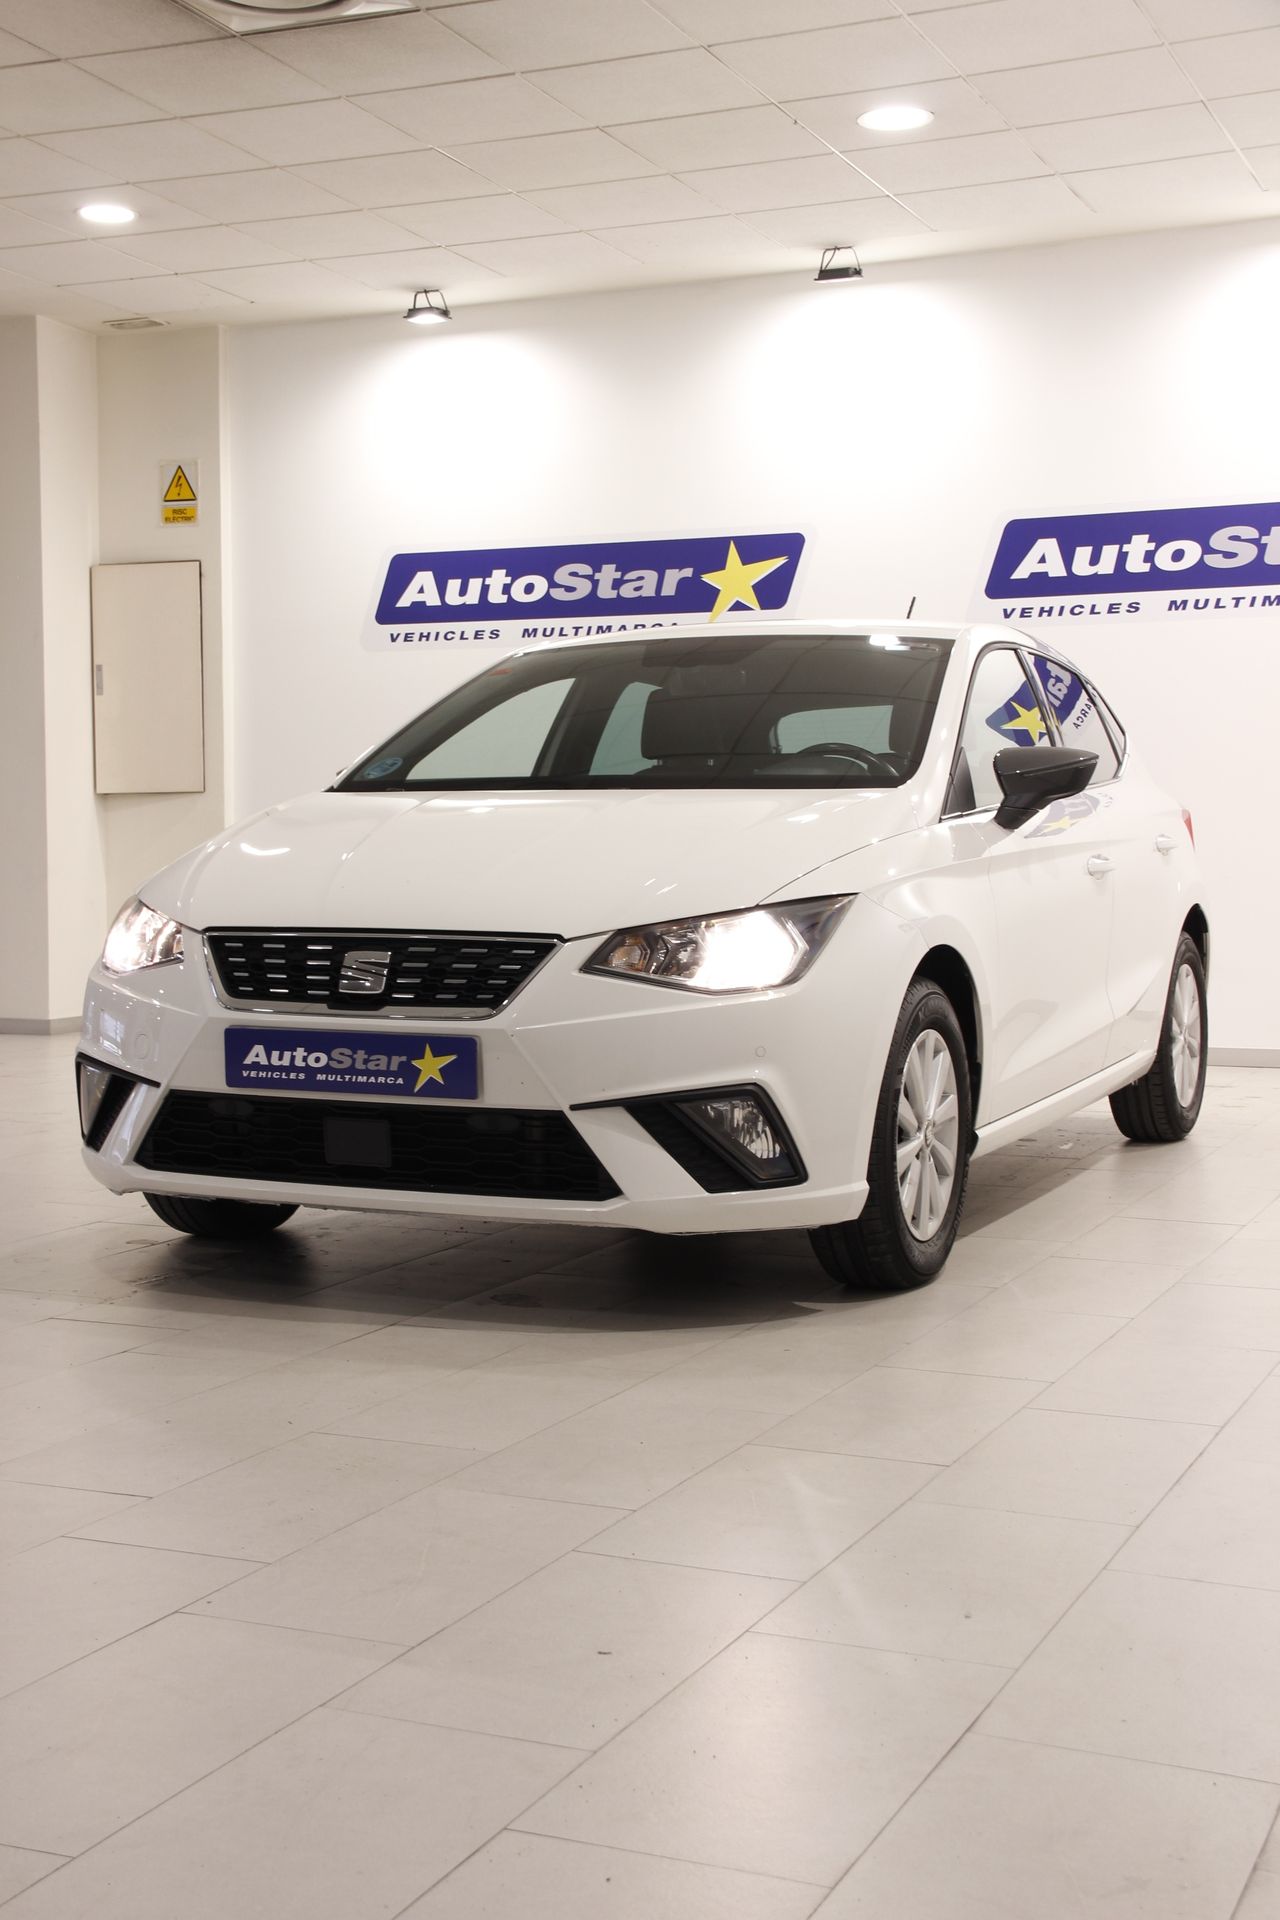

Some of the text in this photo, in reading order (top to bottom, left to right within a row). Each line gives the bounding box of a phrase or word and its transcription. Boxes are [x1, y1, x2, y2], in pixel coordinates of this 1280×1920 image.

[1009, 525, 1280, 580] AutoSt
[395, 563, 694, 608] AutoStar
[1002, 601, 1141, 619] VEHICLES
[389, 628, 501, 643] VEHICLES
[243, 1044, 407, 1071] AutoStar
[241, 1070, 404, 1085] VEHICLES MULTIMARCA
